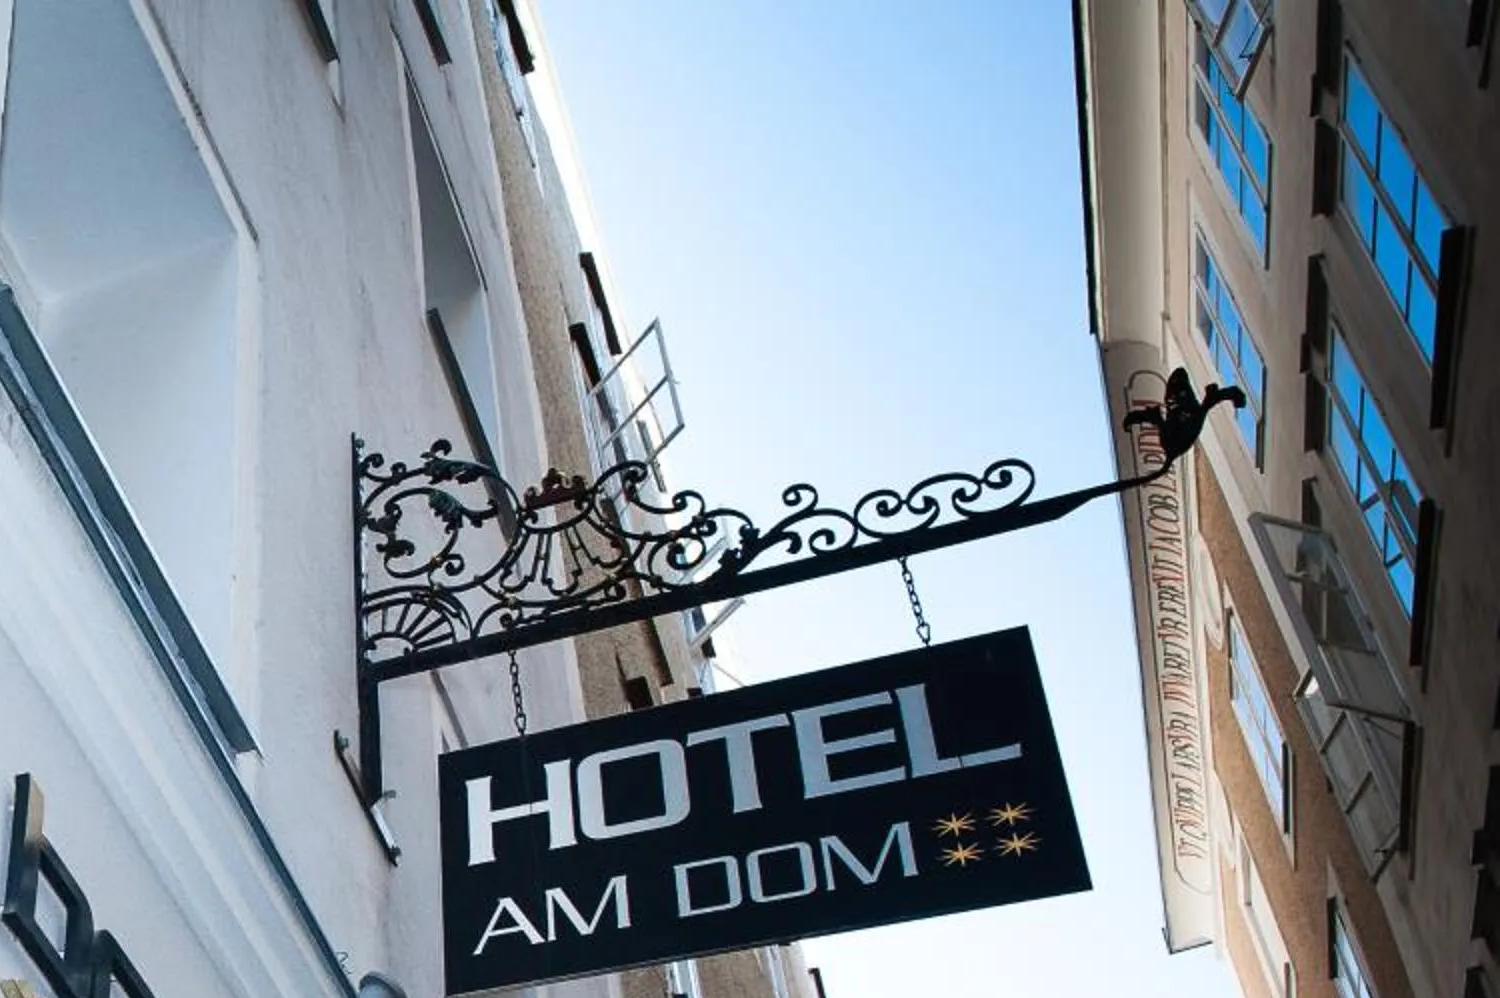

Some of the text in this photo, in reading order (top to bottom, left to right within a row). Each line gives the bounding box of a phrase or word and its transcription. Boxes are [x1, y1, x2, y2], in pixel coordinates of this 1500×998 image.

[464, 683, 1022, 867] HOTEL
[473, 821, 920, 956] AM DOM
